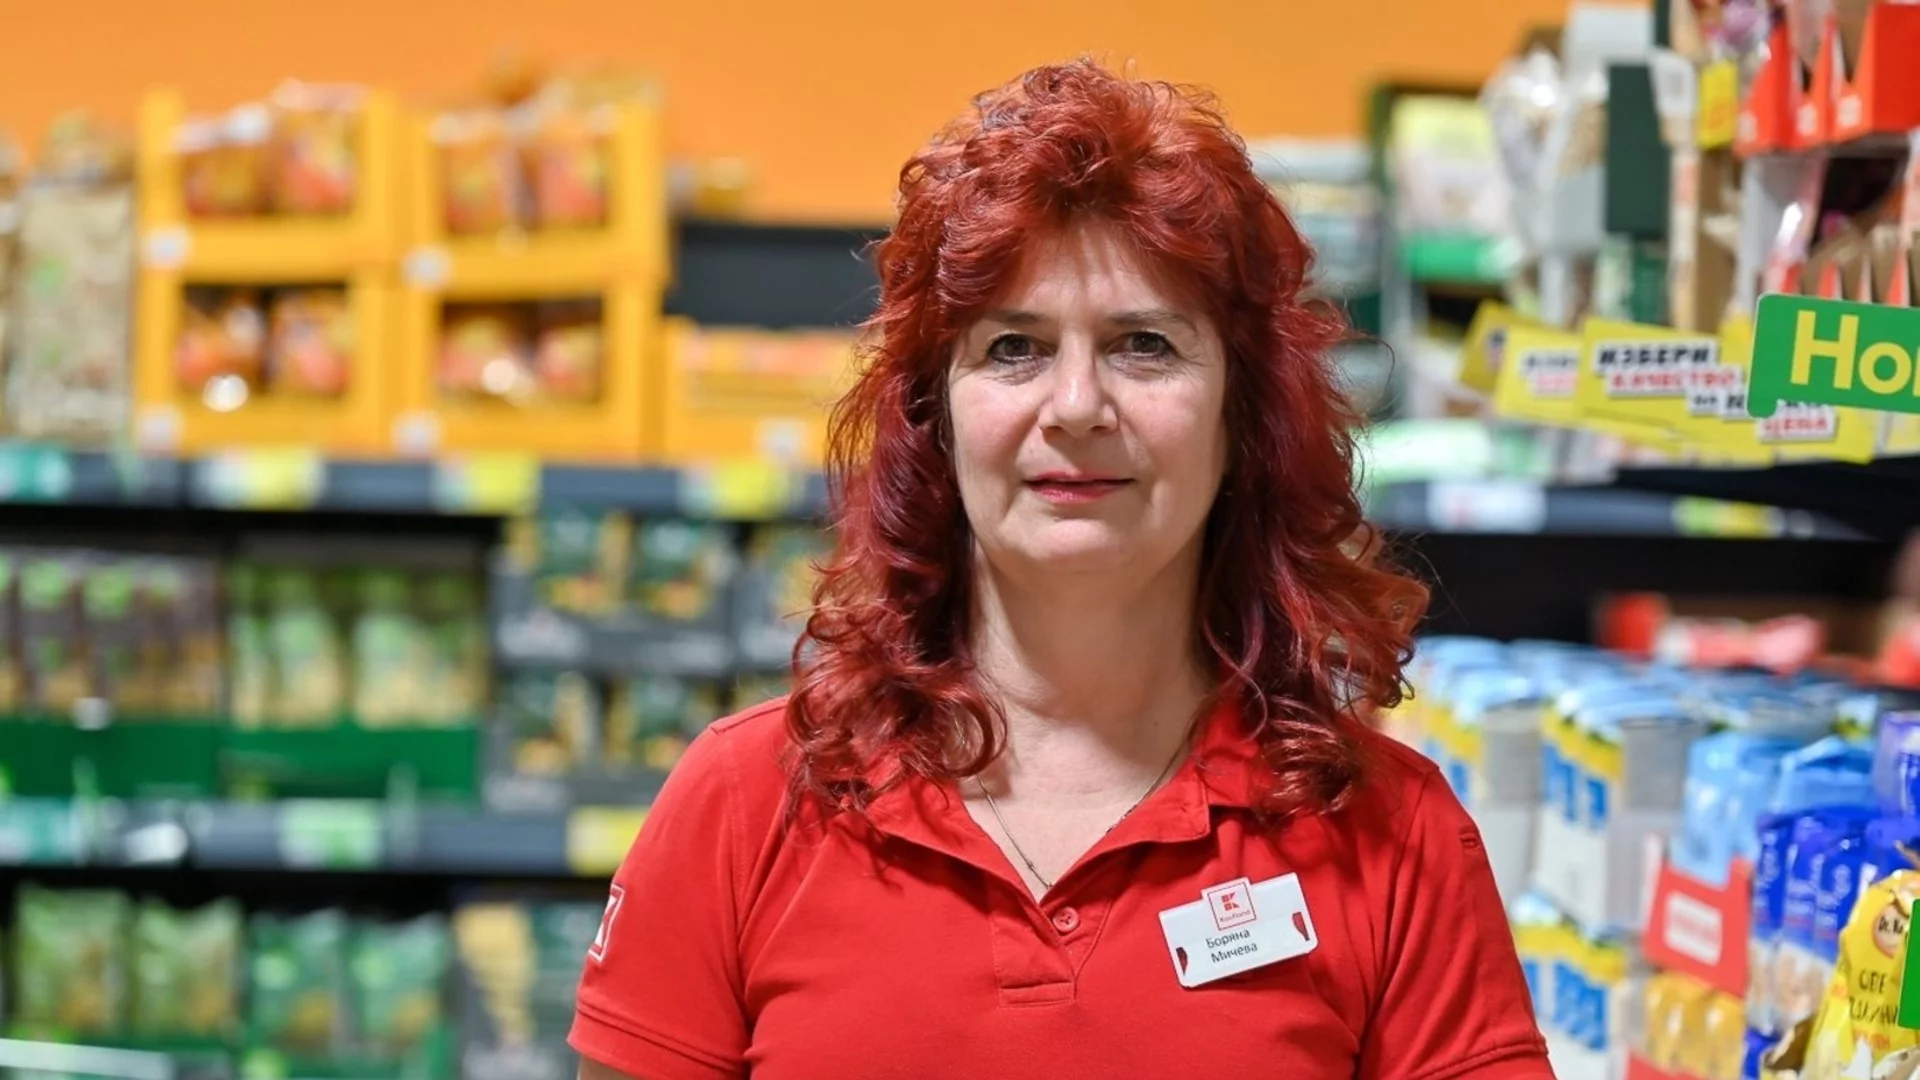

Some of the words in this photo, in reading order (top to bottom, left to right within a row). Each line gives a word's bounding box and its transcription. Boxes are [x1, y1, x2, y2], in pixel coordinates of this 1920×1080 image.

[1599, 344, 1710, 365] ИЗБЕРИ
[1763, 417, 1828, 438] ЦЕНА
[1220, 909, 1251, 922] Kaufland
[1206, 929, 1250, 949] Боряна
[1211, 943, 1258, 963] Мичева
